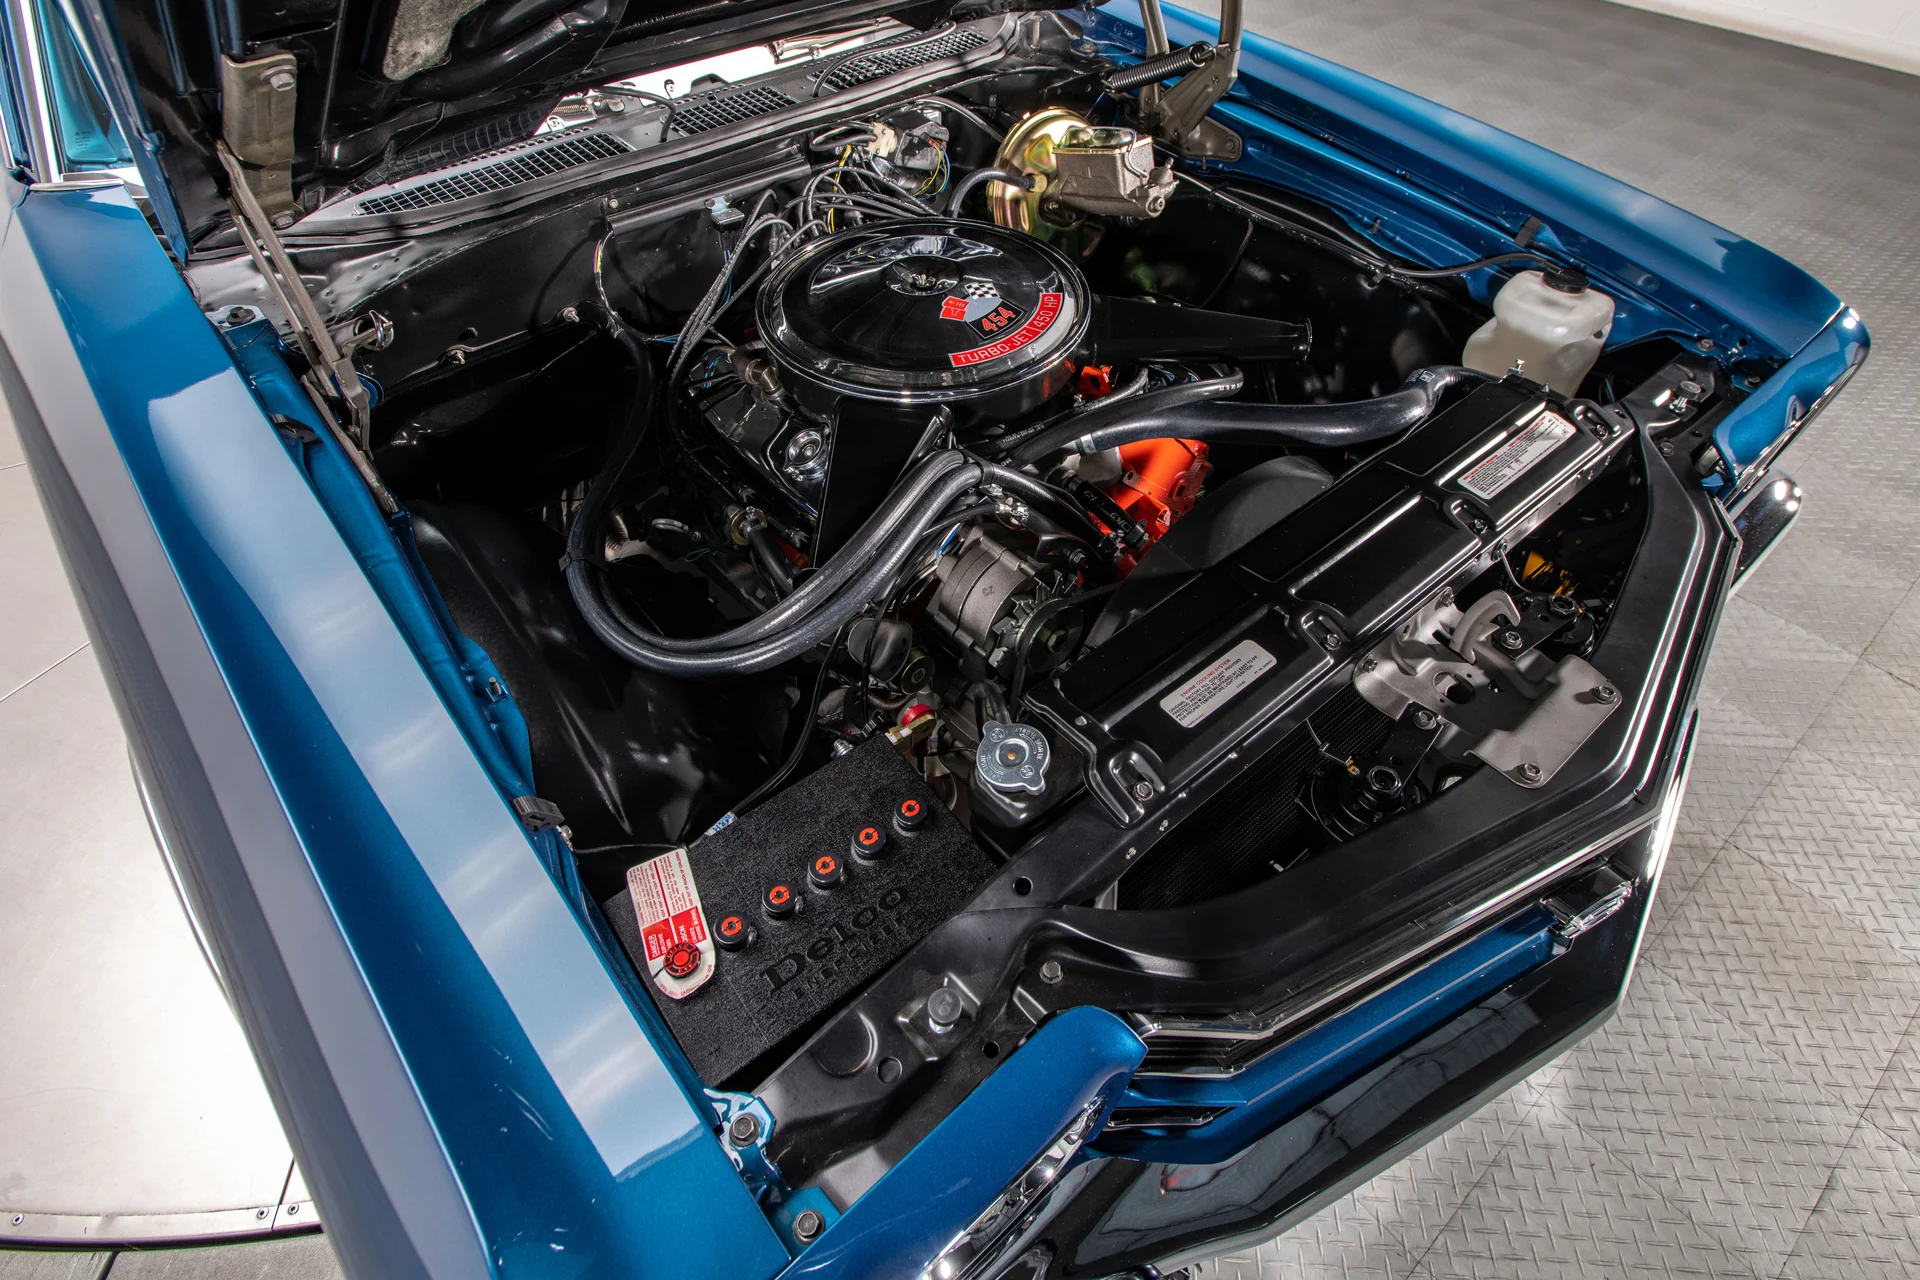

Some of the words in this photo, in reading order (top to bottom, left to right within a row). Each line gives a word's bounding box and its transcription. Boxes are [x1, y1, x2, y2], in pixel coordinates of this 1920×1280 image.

[957, 330, 1034, 363] TURBO-JET
[1035, 310, 1052, 328] 450
[1044, 296, 1058, 308] HP
[982, 307, 1015, 332] 454
[1180, 684, 1197, 697] ENGINE
[1195, 670, 1216, 686] COOLING
[1213, 659, 1231, 672] SYSTEM
[1185, 688, 1202, 700] FACTORY
[1208, 670, 1225, 683] COOLANT
[1224, 658, 1242, 671] PROVIDES
[675, 851, 684, 869] CHILDREN
[690, 909, 699, 926] BURNS
[657, 933, 667, 954] EXPLOSIVE
[678, 925, 689, 944] OISON
[689, 927, 697, 943] CAUSES
[759, 886, 909, 995] Delco
[647, 935, 659, 958] DANGER
